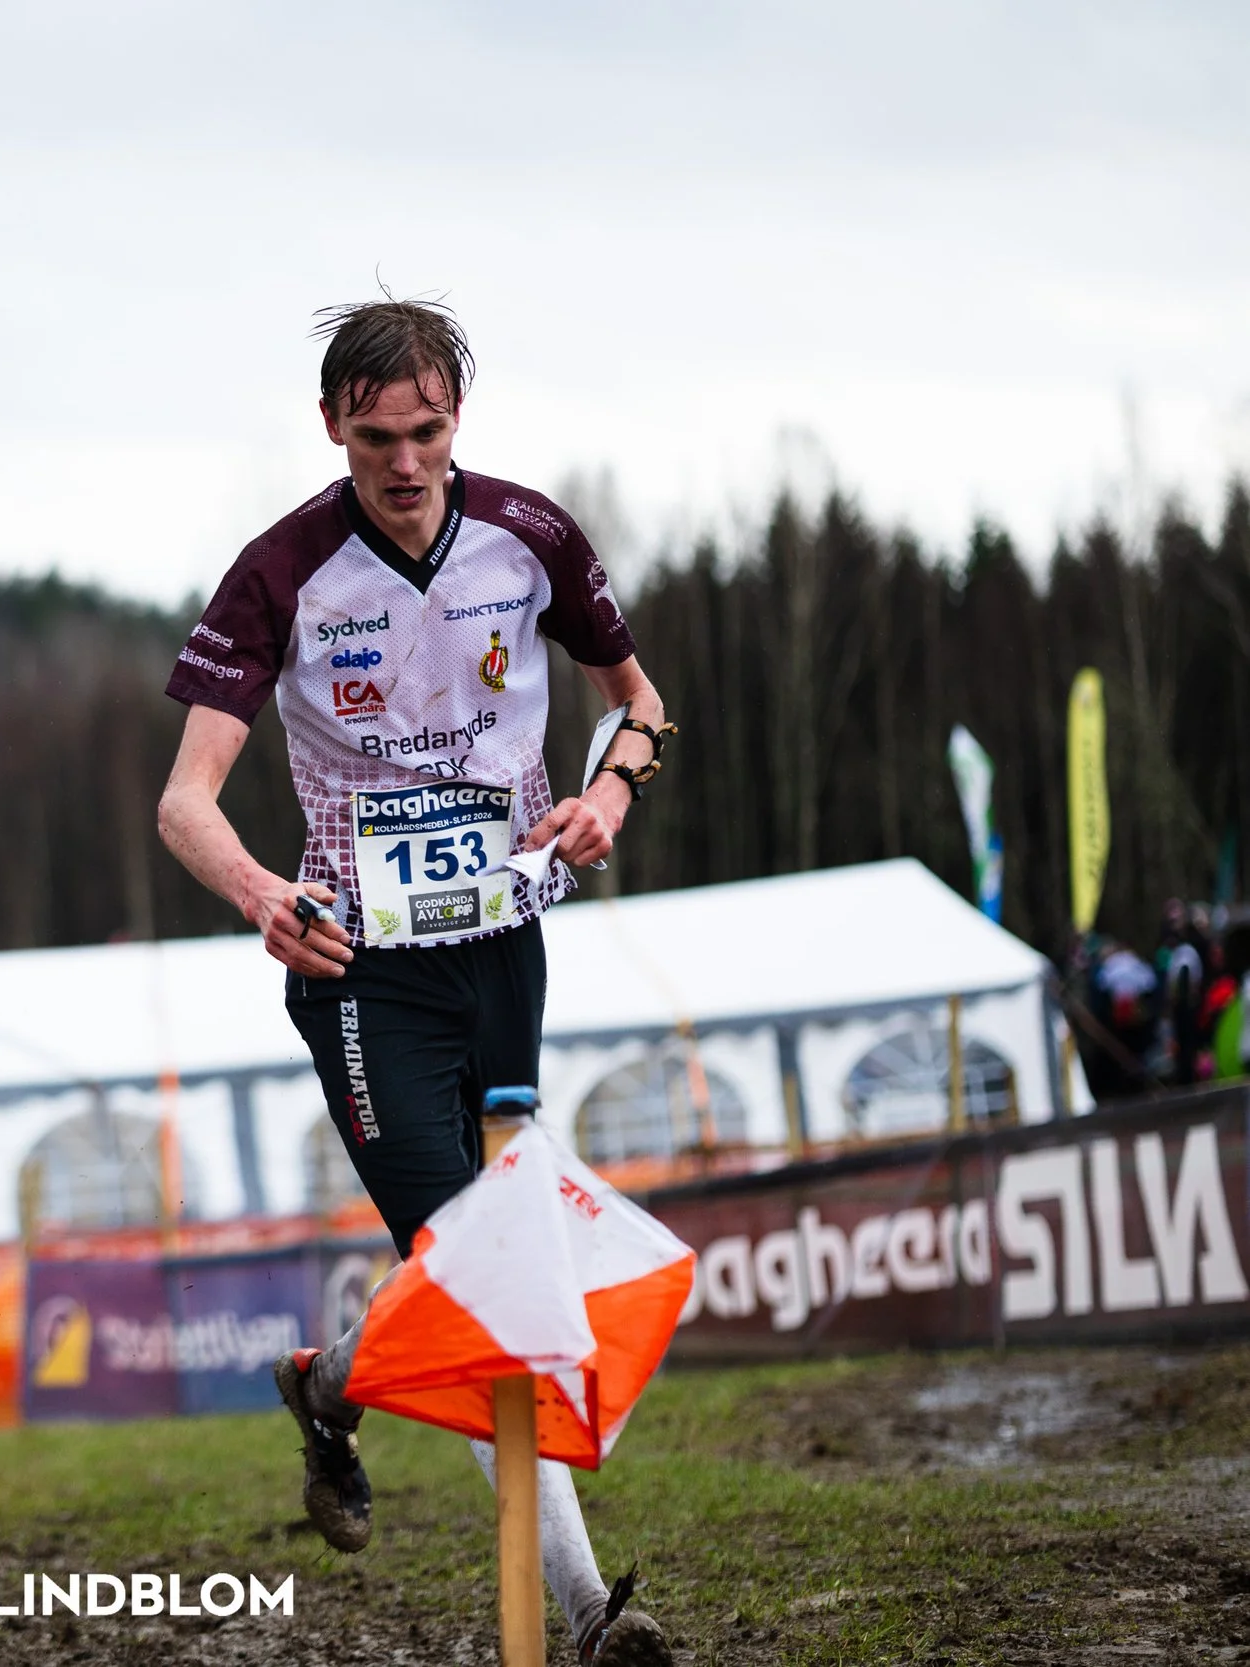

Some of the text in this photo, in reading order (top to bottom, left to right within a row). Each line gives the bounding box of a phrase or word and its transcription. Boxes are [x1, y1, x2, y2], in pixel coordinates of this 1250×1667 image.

[430, 509, 459, 566] noname
[317, 609, 390, 646] Sydved
[331, 647, 382, 671] elajo
[332, 679, 385, 708] ICA
[359, 703, 387, 714] nära
[344, 714, 379, 725] Bredaryd
[361, 710, 497, 758] Bredaryds
[359, 788, 509, 819] bagheera
[374, 819, 450, 833] KOLMÅRDSMEDELN
[461, 814, 472, 822] #2
[473, 812, 493, 821] 2026
[385, 831, 488, 885] 153
[415, 894, 475, 909] GODKÄNDA
[430, 920, 458, 928] SVERIGE
[340, 994, 381, 1141] ERMINATOR
[1000, 1123, 1248, 1322] SILVA
